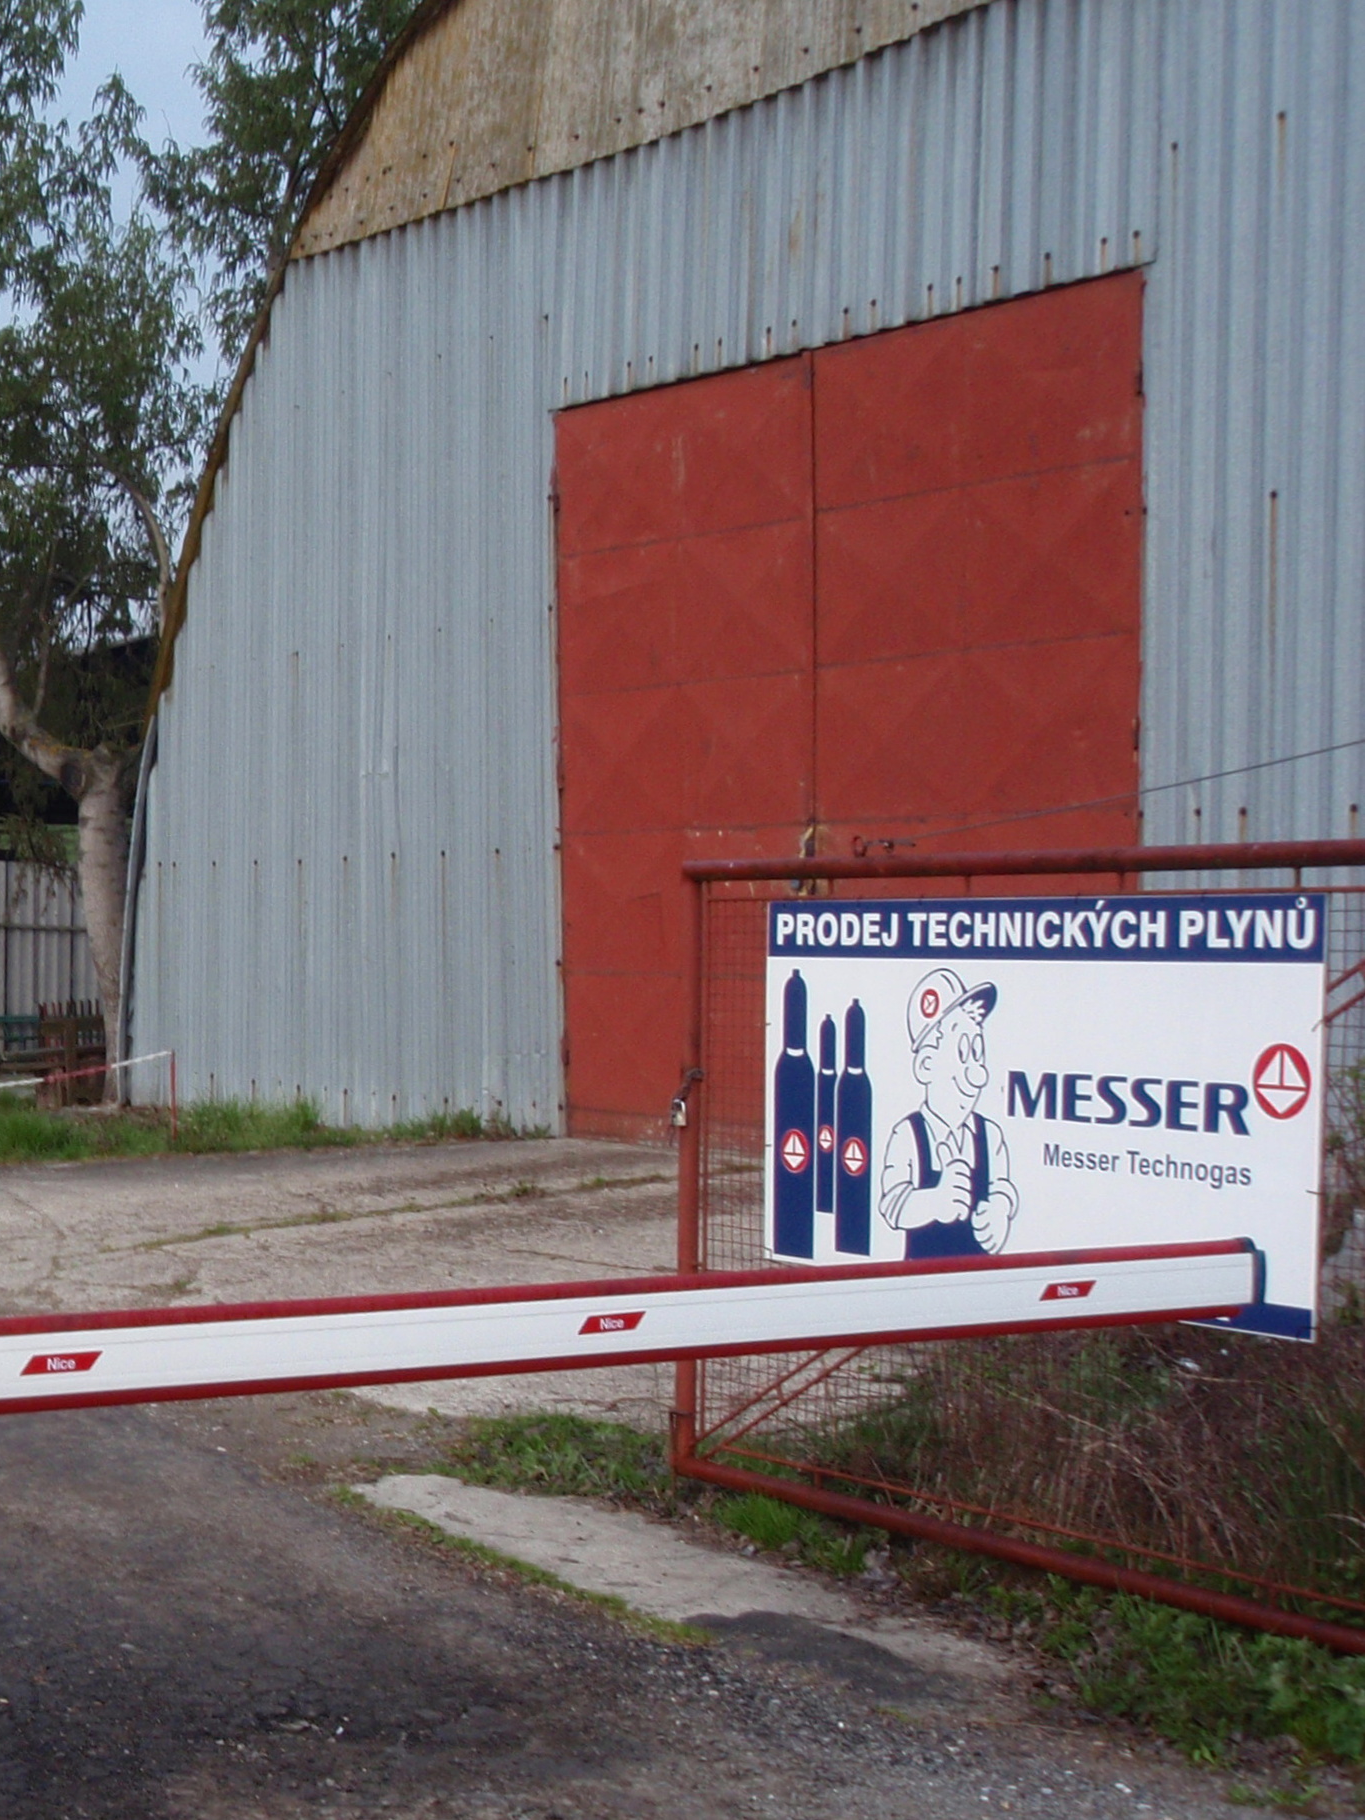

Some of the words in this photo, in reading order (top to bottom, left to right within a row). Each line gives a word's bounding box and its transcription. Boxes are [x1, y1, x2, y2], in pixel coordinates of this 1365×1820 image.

[776, 912, 899, 948] PRODEJ
[911, 899, 1166, 949] TECHNICKÝCH
[1178, 896, 1315, 950] PLYNŮ
[1006, 1069, 1251, 1137] MESSER
[1043, 1142, 1120, 1175] Messer
[1126, 1151, 1252, 1190] Technogas
[599, 1317, 625, 1331] Nice
[46, 1356, 77, 1371] Nice
